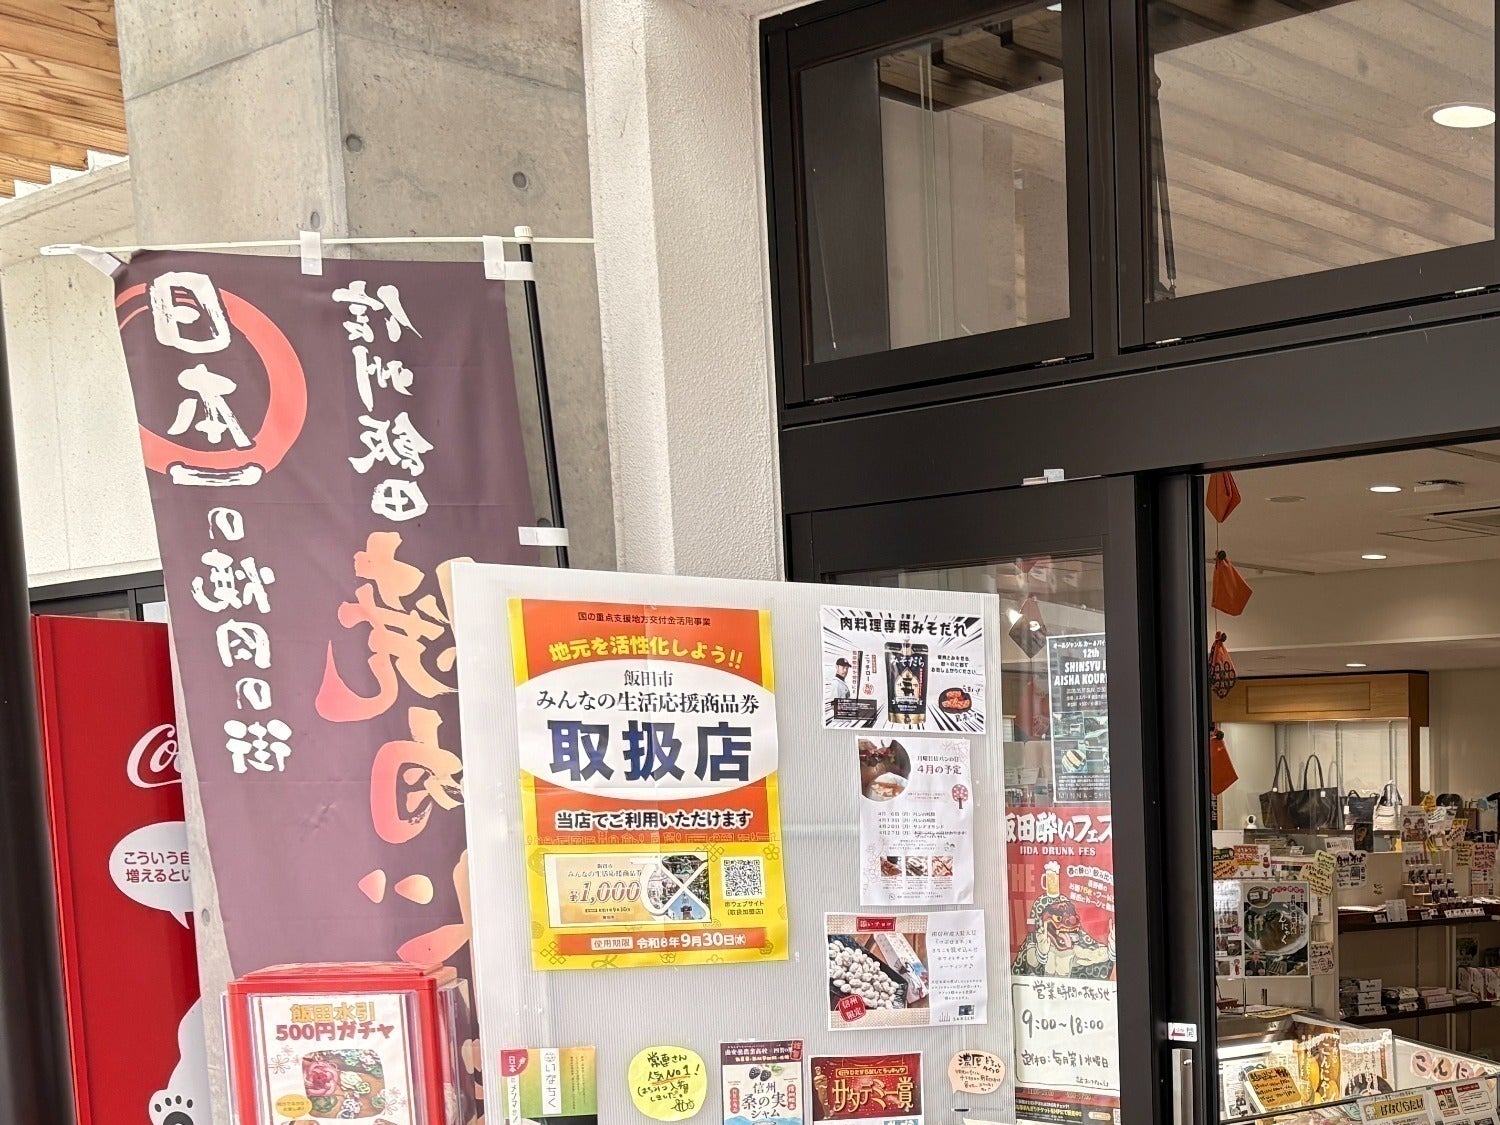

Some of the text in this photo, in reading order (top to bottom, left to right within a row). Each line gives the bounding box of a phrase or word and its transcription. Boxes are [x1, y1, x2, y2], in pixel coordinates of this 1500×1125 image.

[578, 612, 711, 626] 国の重点支援地方交付金活用事業
[840, 617, 967, 637] 肉料理専用みそだれ
[1083, 648, 1099, 658] 12th
[1065, 661, 1101, 673] SHINSYU
[624, 670, 673, 687] 飯田市
[1054, 674, 1080, 686] AISHA
[536, 691, 759, 714] みんなの生活応援商品券
[548, 720, 752, 781] 取扱店
[556, 810, 752, 829] 当店でご利用いただけます
[1042, 846, 1075, 855] DRUNK
[1078, 847, 1096, 856] FES
[592, 938, 631, 949] 使用期限
[290, 1002, 376, 1023] 飯田水引
[276, 1022, 395, 1041] 500円ガチャ
[754, 1082, 776, 1094] 信州
[832, 1076, 914, 1112] サタデミー賞
[742, 1092, 787, 1110] 桑の実
[751, 1108, 780, 1119] ジャム
